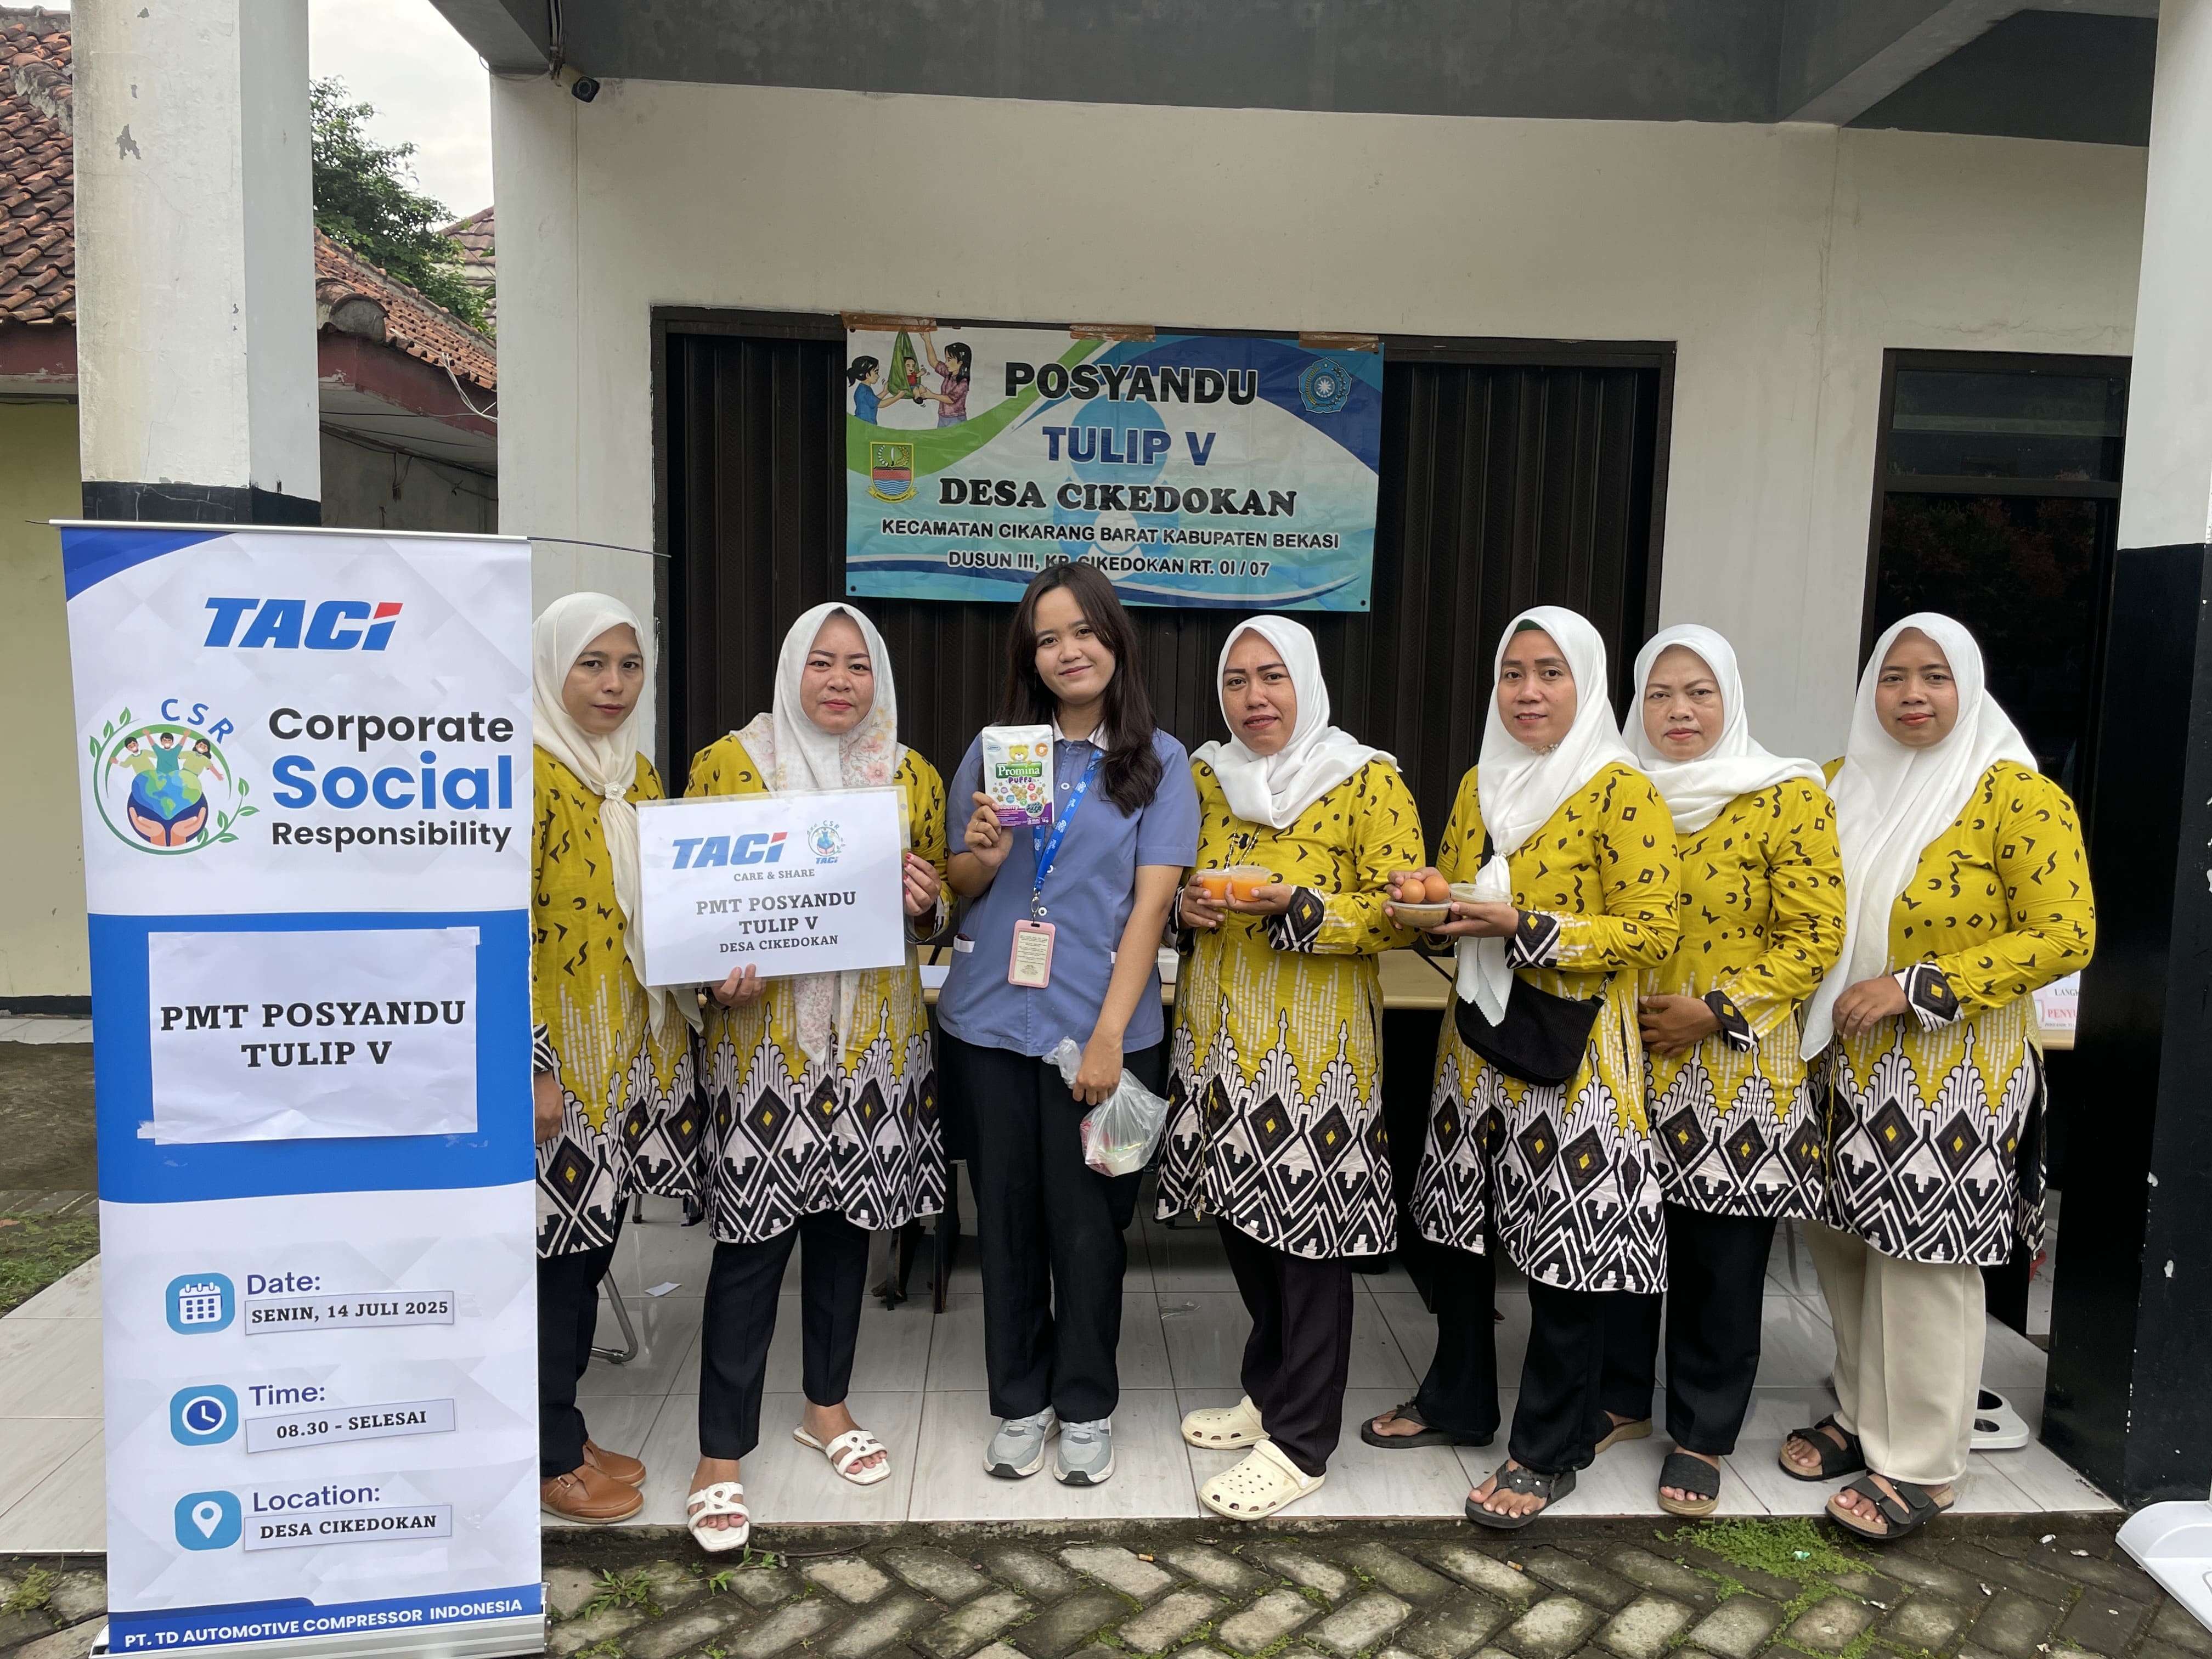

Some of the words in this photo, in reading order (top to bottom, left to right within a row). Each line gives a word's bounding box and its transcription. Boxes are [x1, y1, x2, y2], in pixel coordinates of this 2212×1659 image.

[1005, 362, 1257, 405] POSYANDU
[1042, 426, 1171, 466] TULIP
[1187, 432, 1216, 466] V
[939, 477, 1046, 509] DESA
[1057, 483, 1297, 518] CIKEDOKAN
[882, 520, 994, 538] KECAMATAN
[998, 524, 1093, 541] CIKARANG
[1100, 528, 1158, 545] BARAT
[1163, 530, 1267, 547] KABUPATEN
[1273, 533, 1340, 549] BEKASI
[949, 551, 1012, 568] DUSUN
[1018, 554, 1039, 570] III,
[1189, 560, 1215, 574] RT.
[161, 699, 235, 744] CSR
[269, 708, 514, 752] Corporate
[273, 751, 512, 810] Social
[997, 765, 1040, 776] Promina
[272, 820, 512, 852] Responsibility
[823, 820, 839, 830] CSR
[733, 872, 763, 882] CARE
[778, 869, 815, 879] SHARE
[696, 899, 742, 915] PMT
[749, 891, 856, 911] POSYANDU
[739, 918, 799, 934] TULIP
[805, 916, 819, 930] V
[720, 942, 754, 953] DESA
[759, 935, 838, 950] CIKEDOKAN
[161, 1005, 249, 1030] PMT
[262, 1001, 465, 1028] POSYANDU
[241, 1041, 355, 1068] TULIP
[367, 1041, 392, 1064] V
[247, 1272, 320, 1295] Date:
[252, 1306, 319, 1323] SENIN,
[327, 1304, 348, 1318] 14
[355, 1303, 399, 1317] JULI
[405, 1301, 448, 1315] 2025
[249, 1384, 325, 1406] Time:
[276, 1421, 329, 1438] 08.30
[348, 1410, 426, 1430] SELESAI
[253, 1485, 380, 1511] Location:
[260, 1522, 312, 1539] DESA
[319, 1515, 437, 1535] CIKEDOKAN
[125, 1634, 151, 1647] PT.
[156, 1633, 178, 1644] TD
[183, 1621, 300, 1642] AUTOMOTIVE
[303, 1609, 422, 1632] COMPRESSOR
[430, 1599, 523, 1620] INDONESIA
